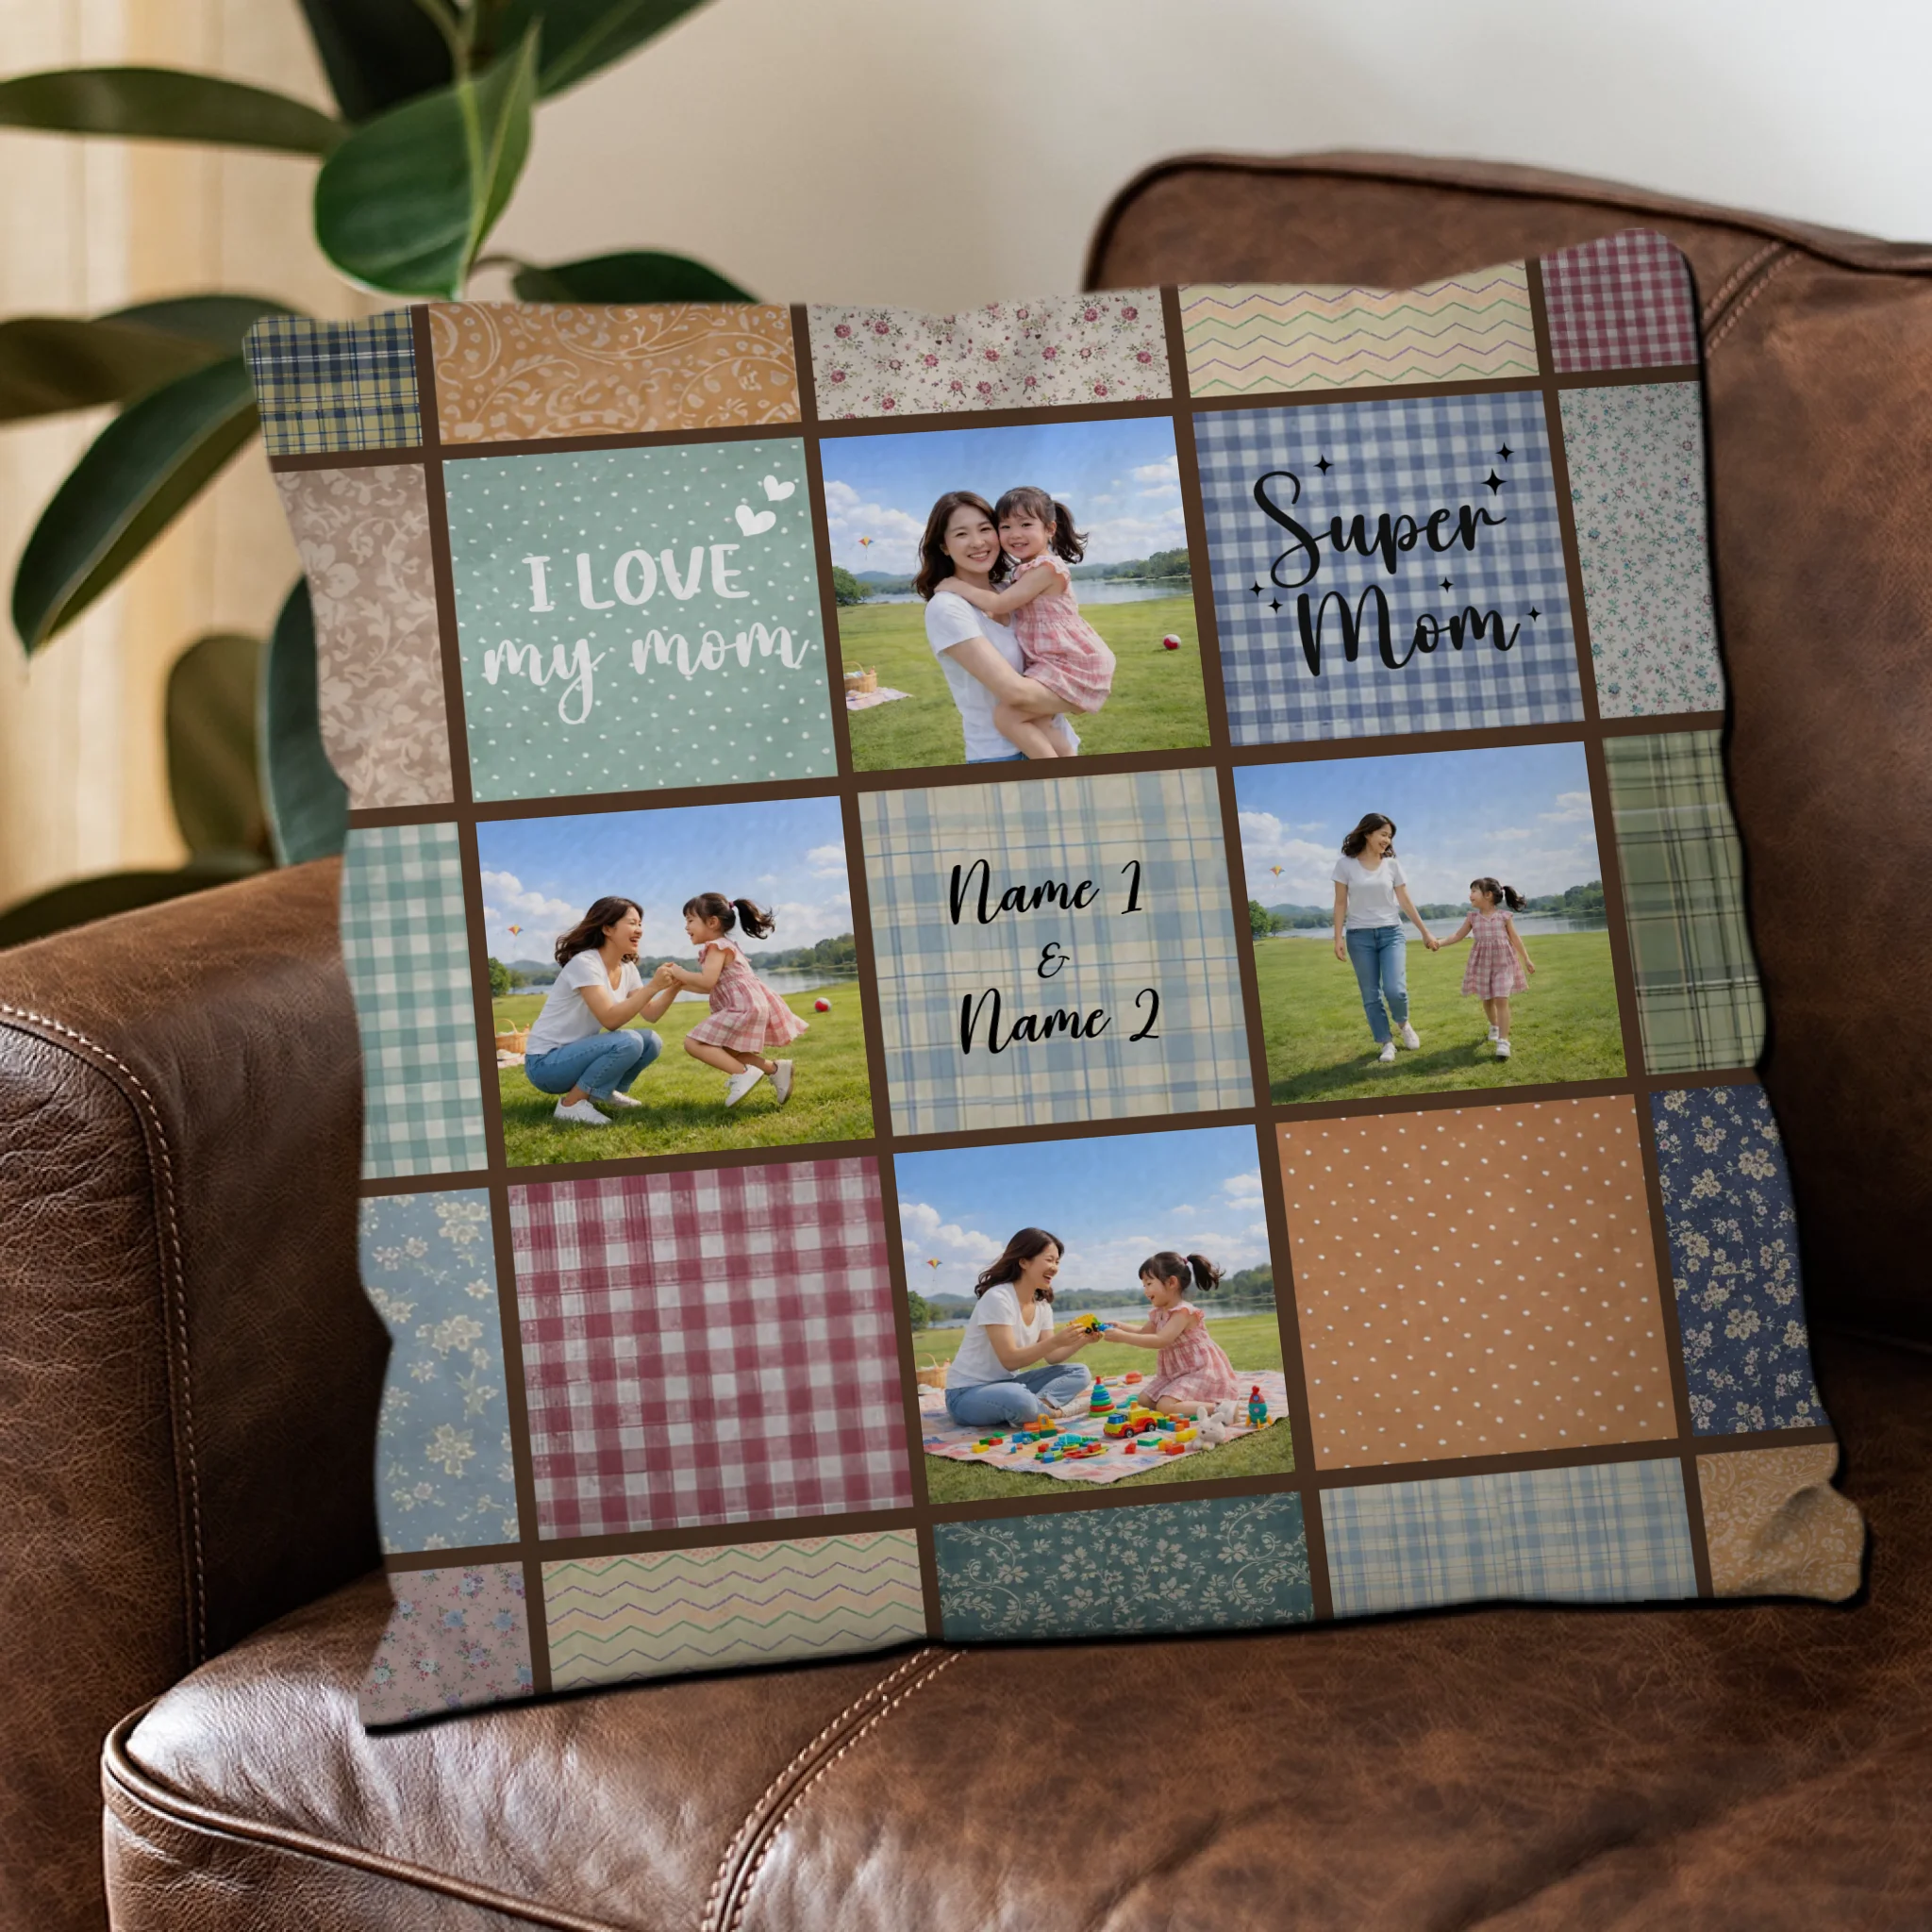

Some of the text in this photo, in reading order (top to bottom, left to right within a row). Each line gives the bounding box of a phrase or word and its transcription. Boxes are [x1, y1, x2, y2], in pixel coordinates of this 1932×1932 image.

[1253, 471, 1507, 589] Super
[522, 543, 750, 612] I LOVE
[1297, 585, 1521, 676] Mom
[484, 622, 809, 724] my mom
[949, 858, 1142, 924] Name 1
[1037, 941, 1070, 978] &
[960, 988, 1159, 1055] Name 2
